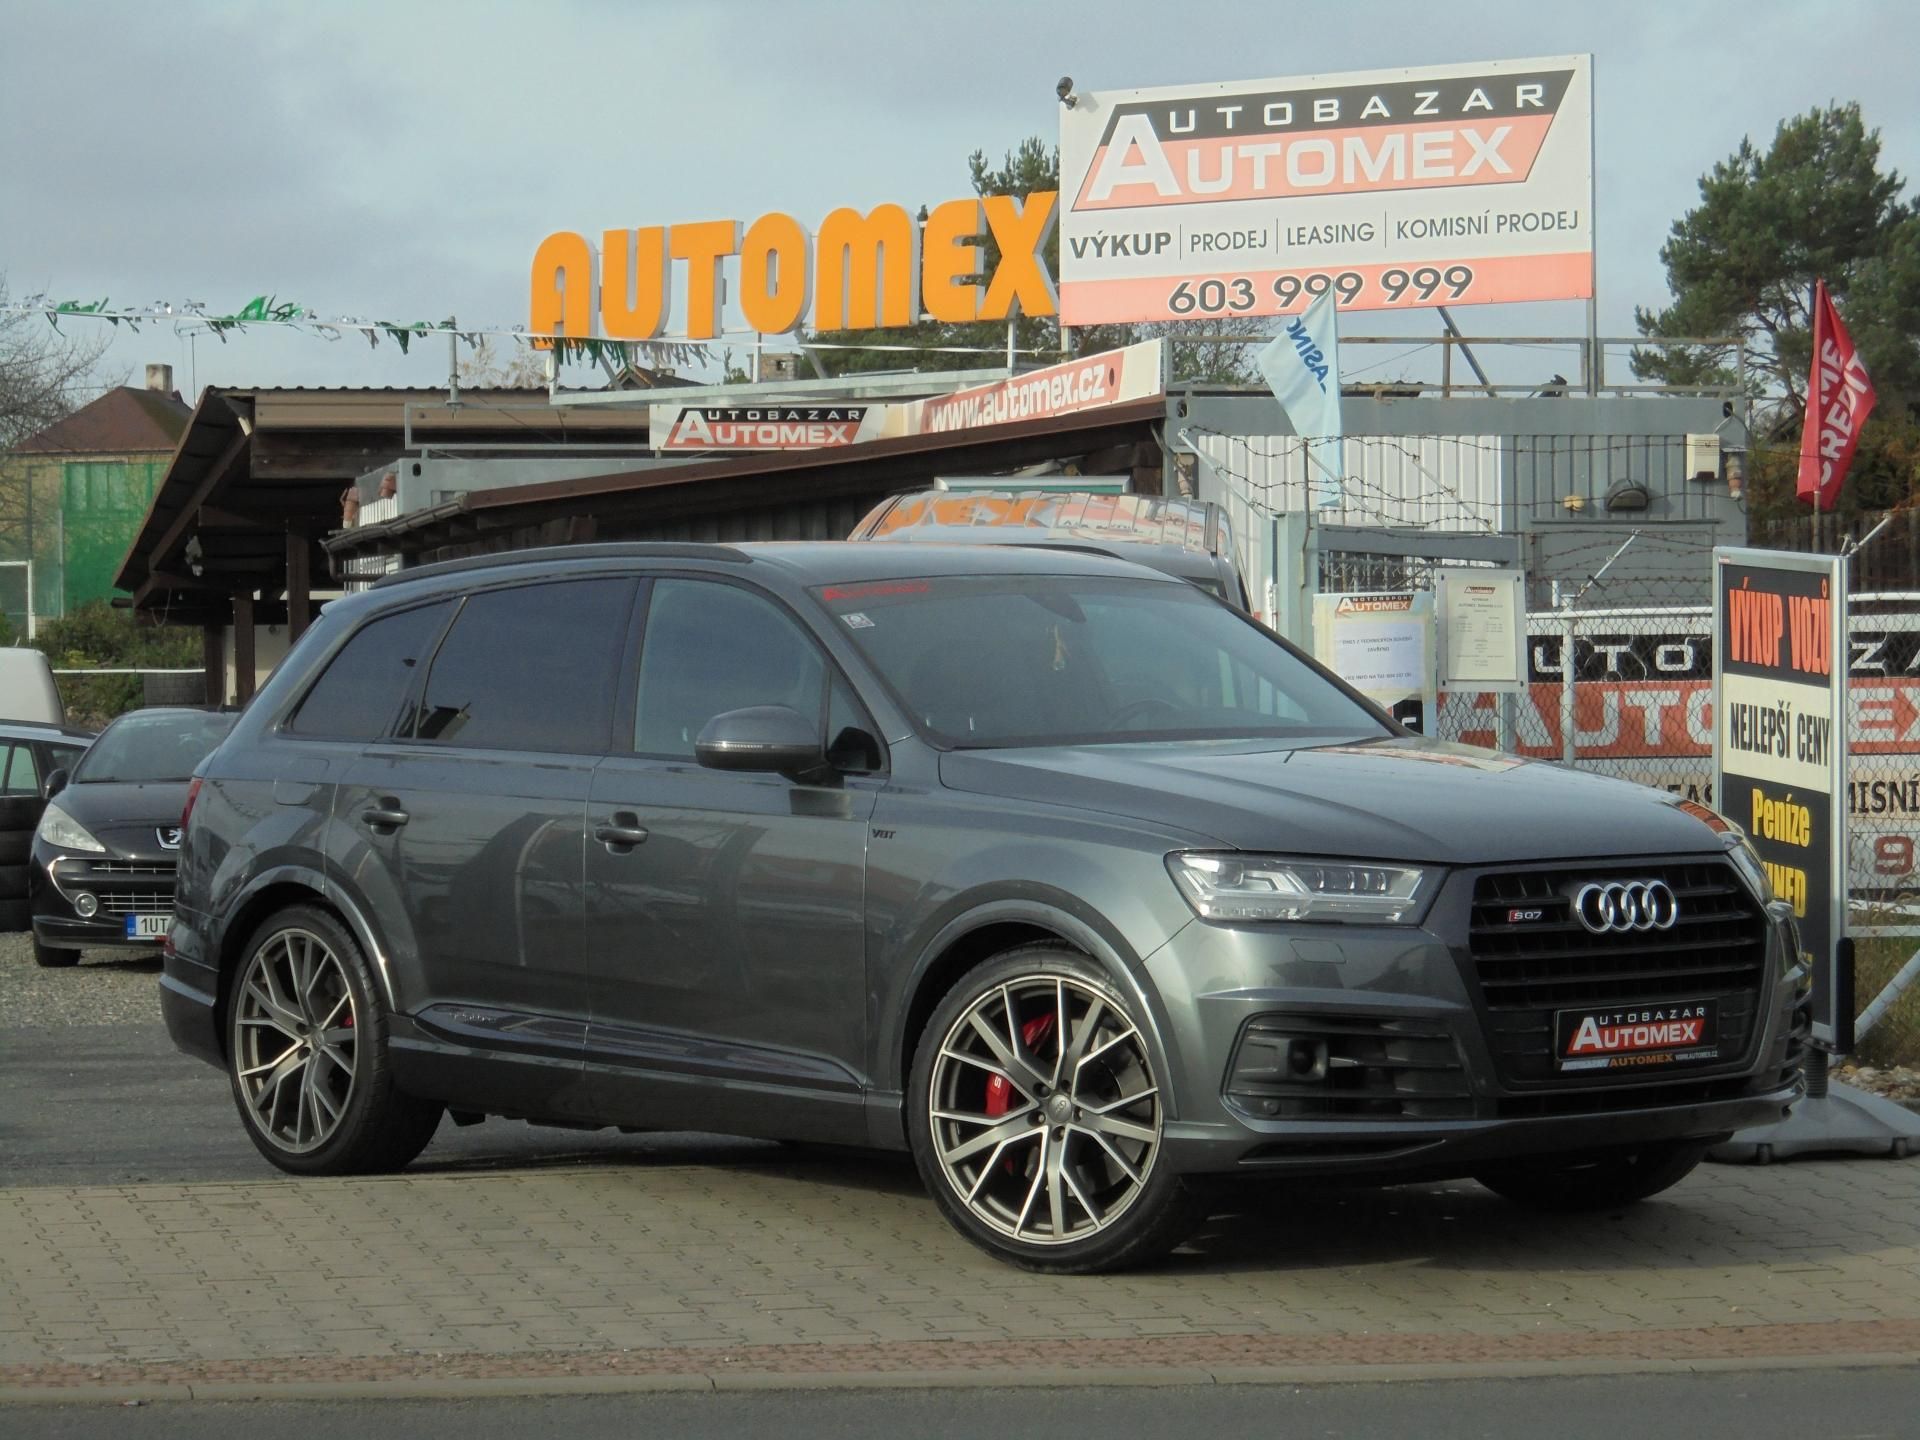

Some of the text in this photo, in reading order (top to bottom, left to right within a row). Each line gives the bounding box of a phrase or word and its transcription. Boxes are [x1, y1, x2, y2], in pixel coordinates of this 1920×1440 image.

[1086, 113, 1513, 201] AUTOMEX
[1069, 209, 1579, 259] VÝKUP PRODEJ LEASING KOMISNÍ PRODEJ
[530, 191, 1058, 350] AUTOMEX
[1169, 265, 1473, 314] 603 999 999
[931, 364, 1105, 432] www.automex.cz
[673, 410, 849, 444] AUTOMEX
[1338, 597, 1408, 612] AUTOMEX
[1729, 576, 1831, 676] VÝKUP VOZŮ
[1730, 699, 1830, 767] NEJLEPŠÍ CENY
[1752, 788, 1811, 848] Peníze
[141, 917, 168, 933] 1UT
[1572, 1016, 1696, 1050] AUTOMEX
[1609, 1052, 1674, 1068] AUTOMEX
